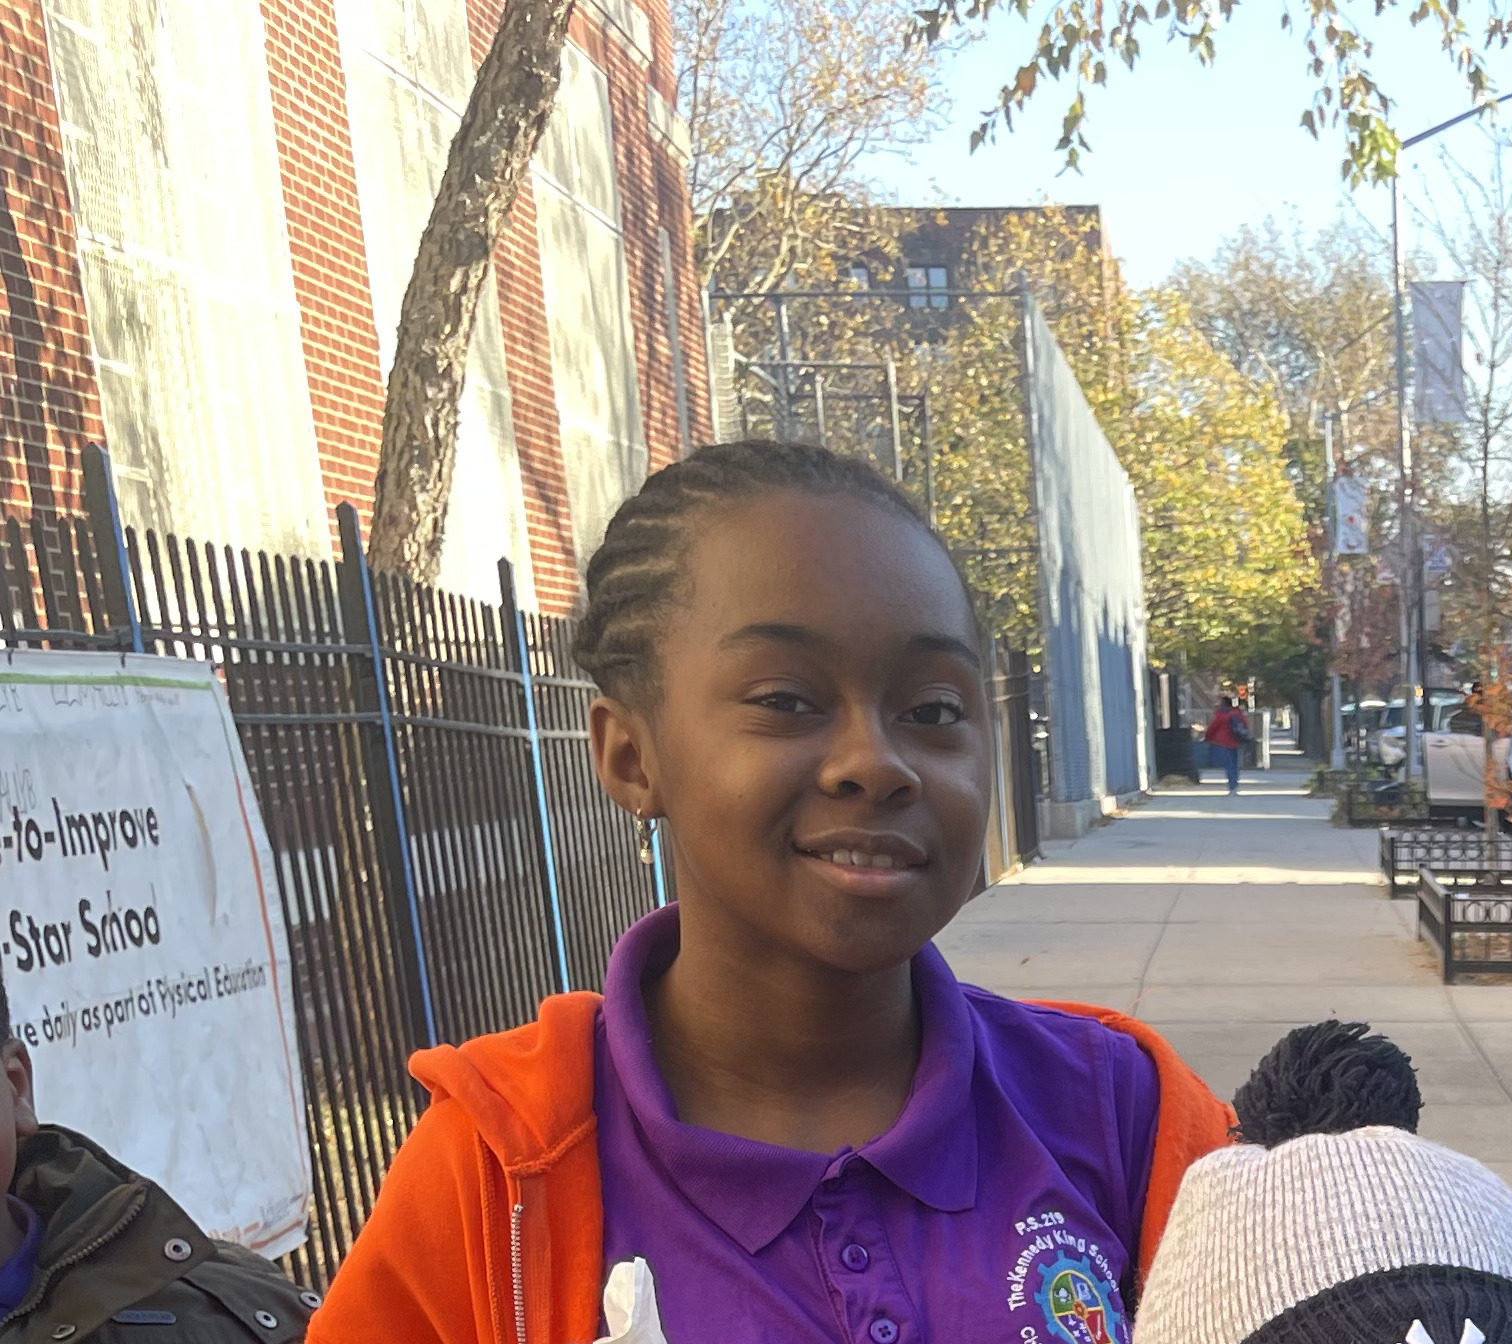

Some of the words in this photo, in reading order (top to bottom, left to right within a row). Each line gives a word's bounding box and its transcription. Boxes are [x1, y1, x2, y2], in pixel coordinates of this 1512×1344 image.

[0, 796, 160, 872] -to-Improve
[81, 1004, 102, 1032] as
[138, 979, 157, 1018] of
[1052, 1229, 1085, 1253] King
